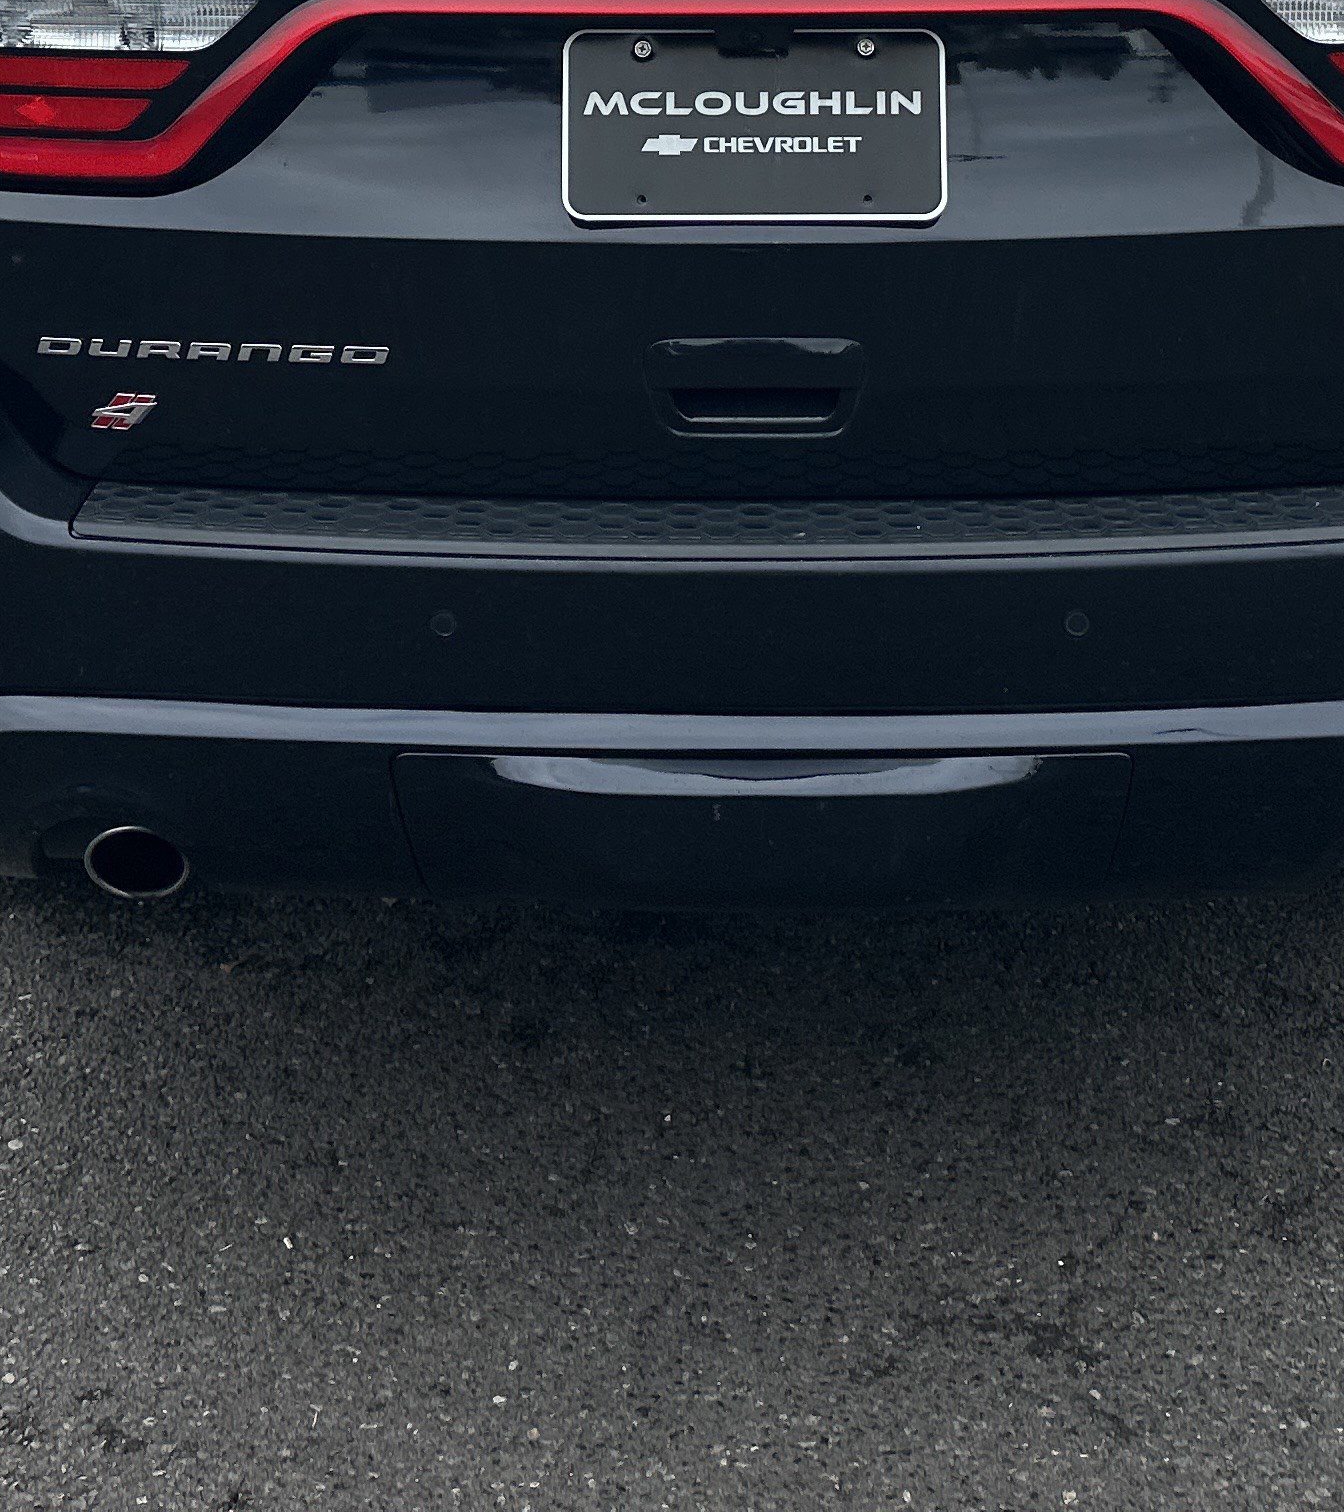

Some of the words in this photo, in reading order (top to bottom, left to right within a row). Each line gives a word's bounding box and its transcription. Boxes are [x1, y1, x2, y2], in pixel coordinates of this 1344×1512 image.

[583, 90, 922, 116] MCLOUGHLIN
[703, 136, 862, 154] CHEVROLET
[37, 336, 390, 365] DURANGO
